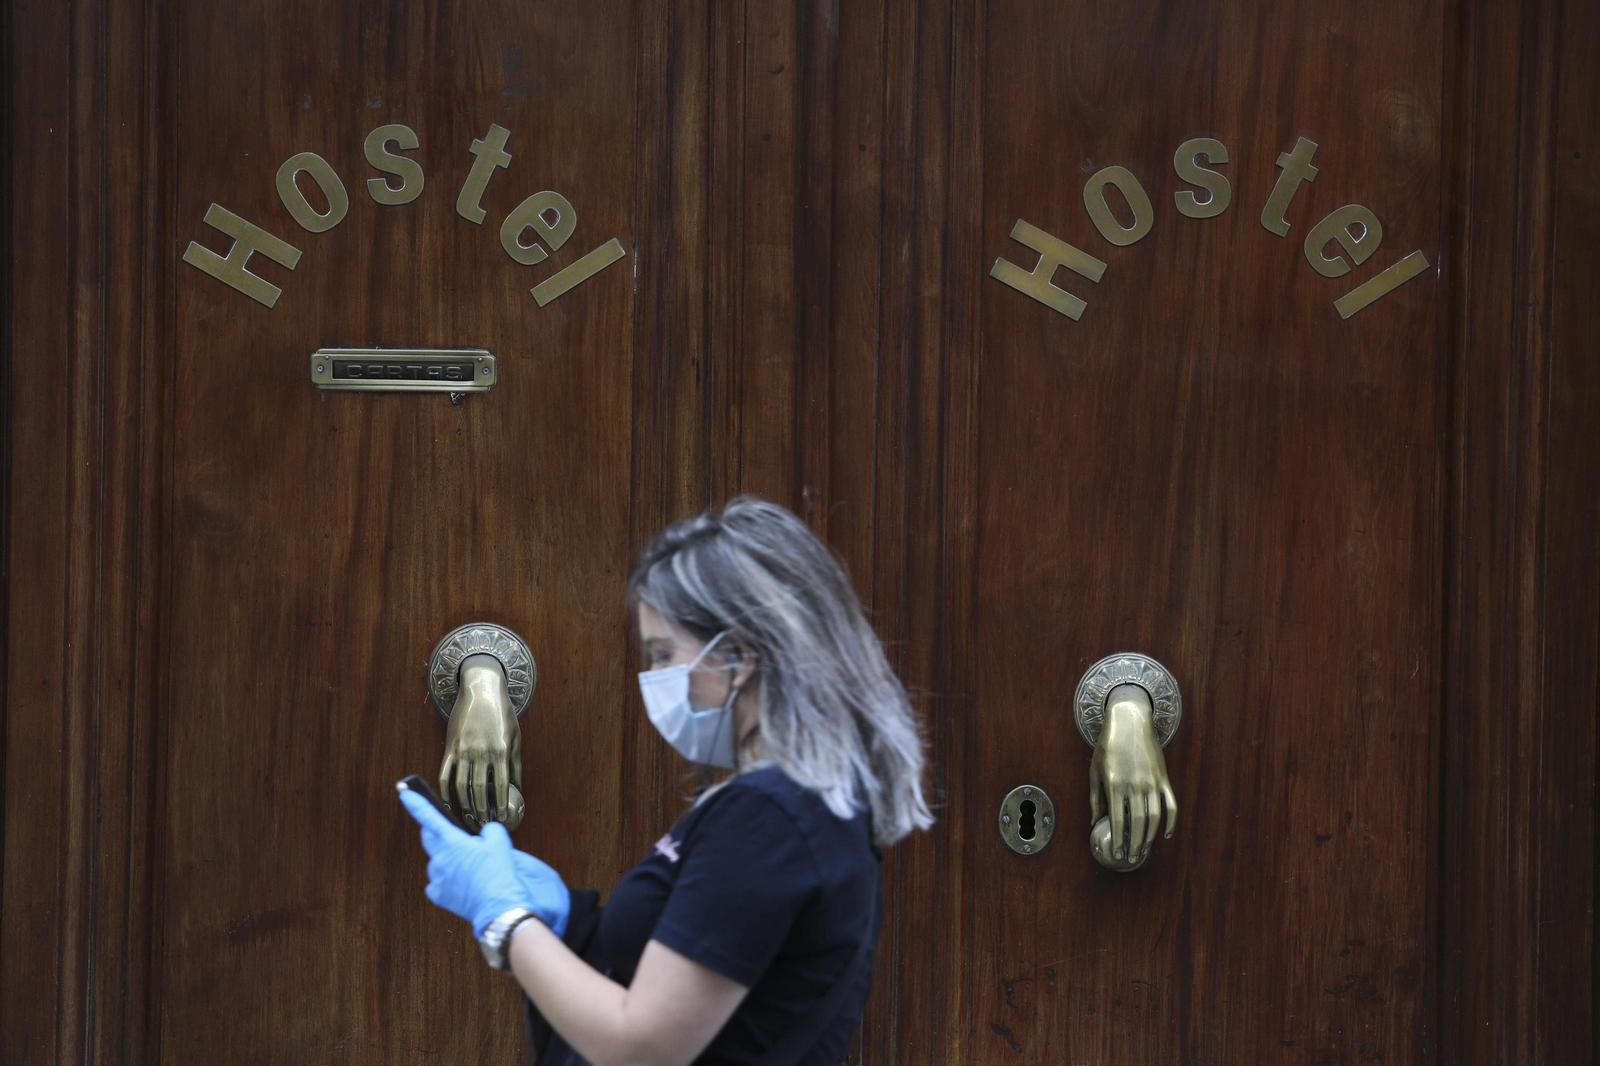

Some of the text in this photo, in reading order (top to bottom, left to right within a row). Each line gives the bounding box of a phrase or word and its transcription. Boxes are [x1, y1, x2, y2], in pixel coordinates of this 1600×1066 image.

[182, 123, 626, 309] Hostel
[989, 136, 1430, 322] Hostel
[346, 364, 463, 380] CARTAS
